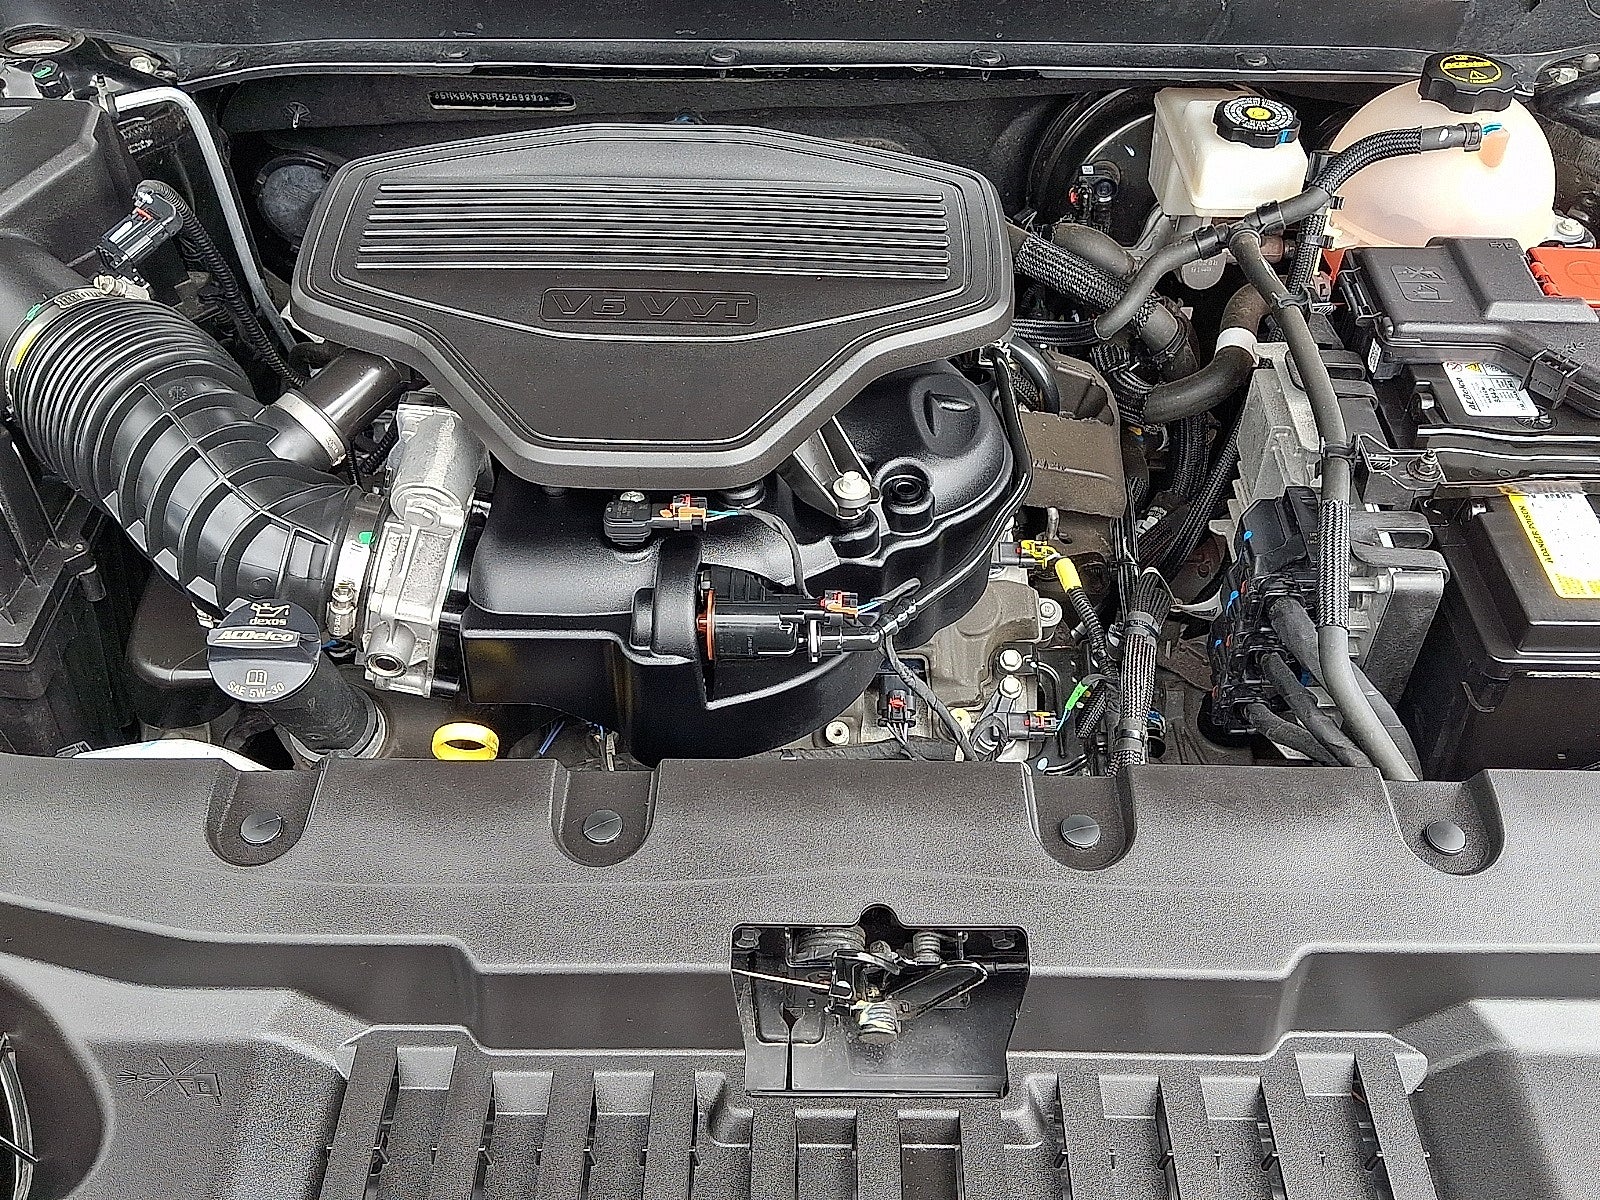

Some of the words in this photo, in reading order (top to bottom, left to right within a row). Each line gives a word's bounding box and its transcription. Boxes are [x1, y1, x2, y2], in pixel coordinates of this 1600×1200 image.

[551, 294, 628, 315] V6
[638, 295, 750, 318] VVT
[249, 617, 287, 626] dexos
[217, 630, 294, 641] ACDelco
[227, 681, 246, 697] SAE
[249, 682, 285, 697] 5W-30
